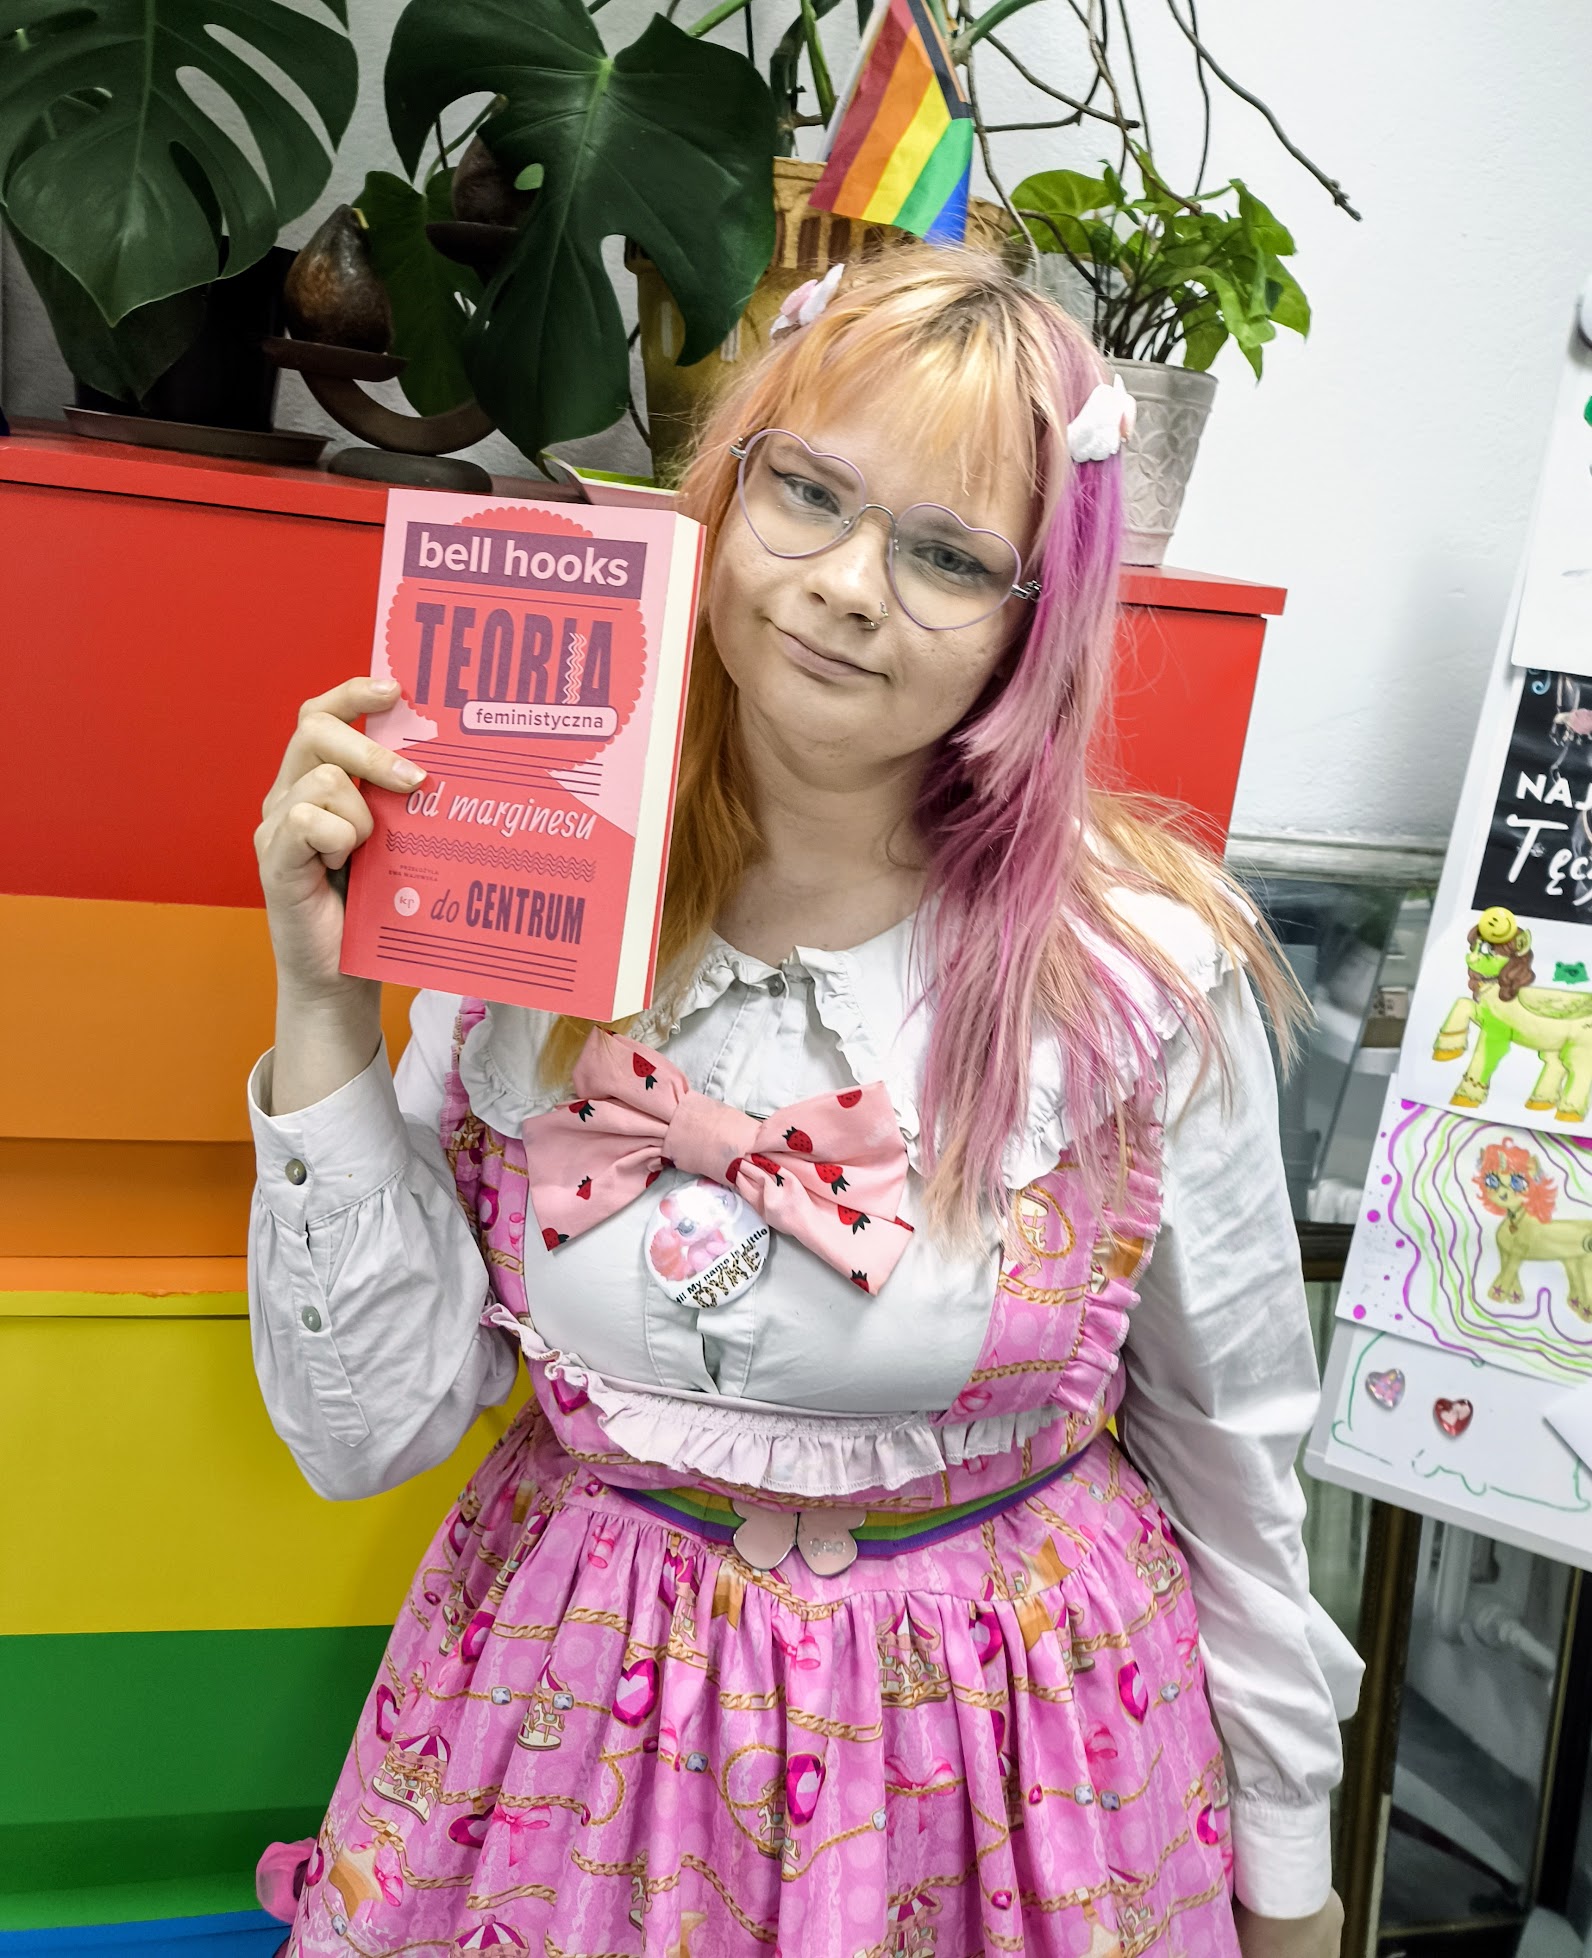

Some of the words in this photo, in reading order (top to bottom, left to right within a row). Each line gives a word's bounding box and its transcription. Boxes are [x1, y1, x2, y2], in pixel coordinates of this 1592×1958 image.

[418, 531, 492, 574] bell
[503, 539, 630, 588] hooks
[413, 601, 614, 710] TEORIA
[476, 708, 604, 730] feministyczna
[405, 780, 447, 818] od
[447, 793, 599, 840] marginesu
[430, 888, 461, 923] do
[465, 879, 586, 945] CENTRUM
[687, 1279, 703, 1295] My
[703, 1257, 730, 1281] name
[741, 1228, 768, 1250] Little
